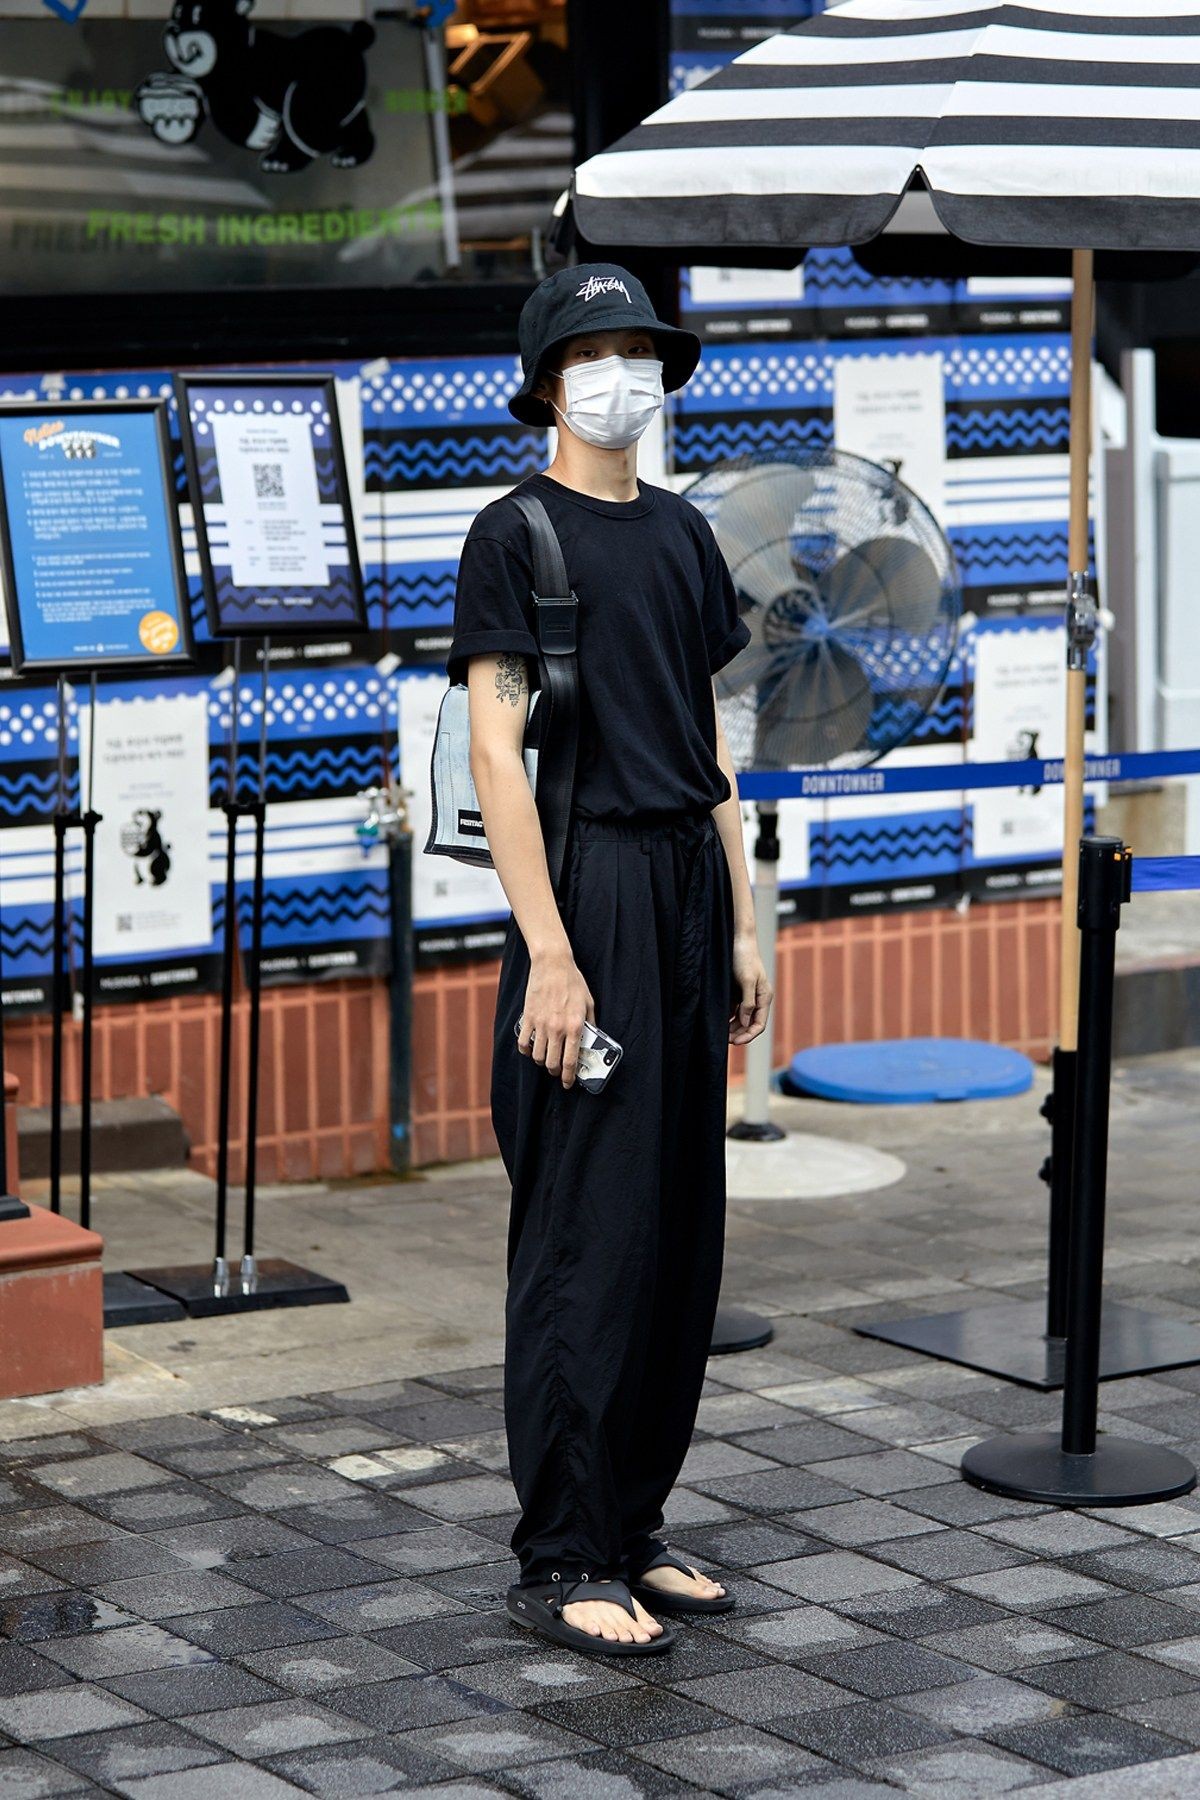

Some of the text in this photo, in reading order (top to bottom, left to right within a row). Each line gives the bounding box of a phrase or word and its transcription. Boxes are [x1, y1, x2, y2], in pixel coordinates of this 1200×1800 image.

[87, 210, 206, 245] FRESH
[217, 201, 442, 247] INGREDIENTS
[802, 773, 884, 795] DOWNTOWNER
